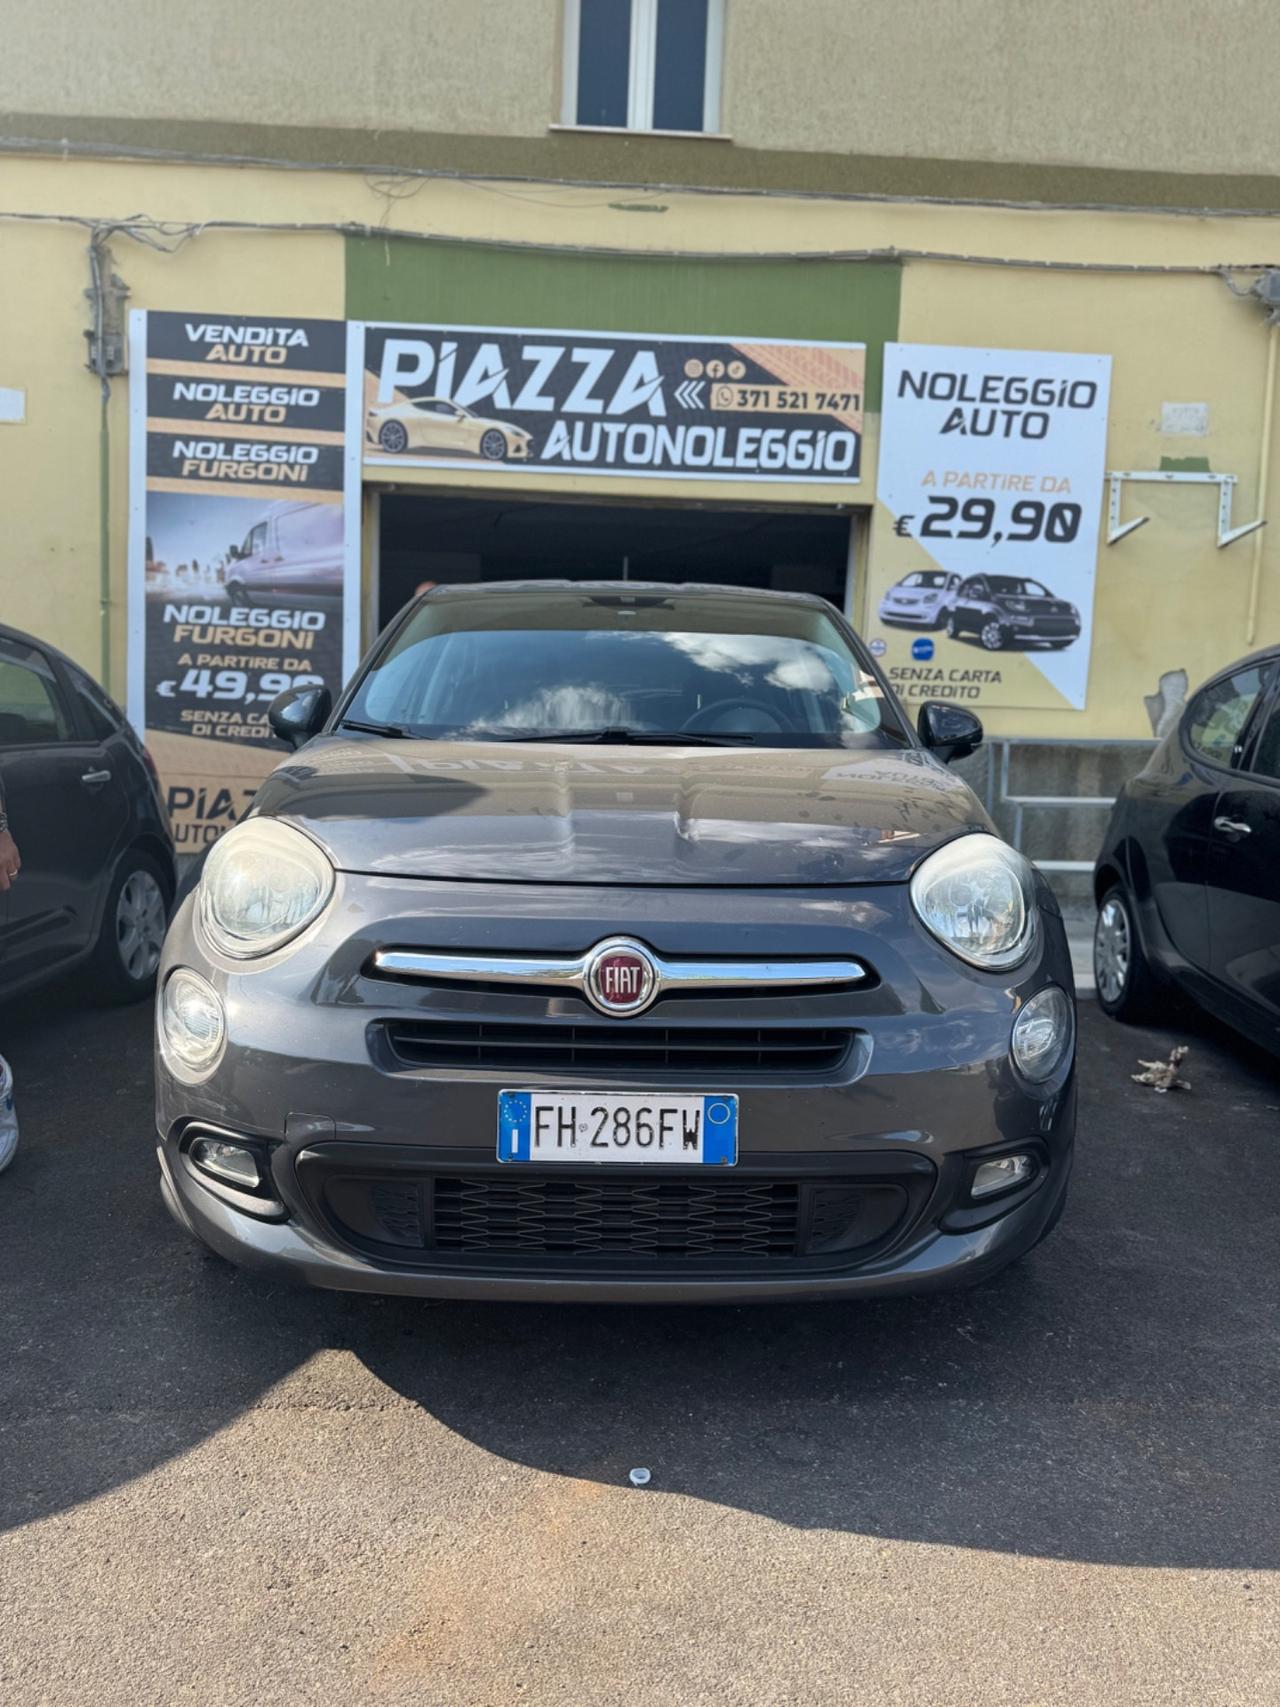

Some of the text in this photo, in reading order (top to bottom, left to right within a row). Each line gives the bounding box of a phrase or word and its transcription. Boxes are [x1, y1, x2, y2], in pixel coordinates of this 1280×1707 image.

[205, 344, 287, 365] AUTO
[736, 388, 861, 412] 371 521 7471
[205, 403, 287, 423] AUTO
[939, 407, 1051, 440] AUTO
[921, 470, 937, 487] A
[1039, 475, 1072, 494] DA
[177, 653, 193, 666] A
[282, 658, 312, 672] DA
[888, 667, 1002, 683] SENZA CARTA
[180, 709, 242, 725] SENZA
[215, 725, 277, 738] CREDI
[606, 966, 641, 994] FIAT
